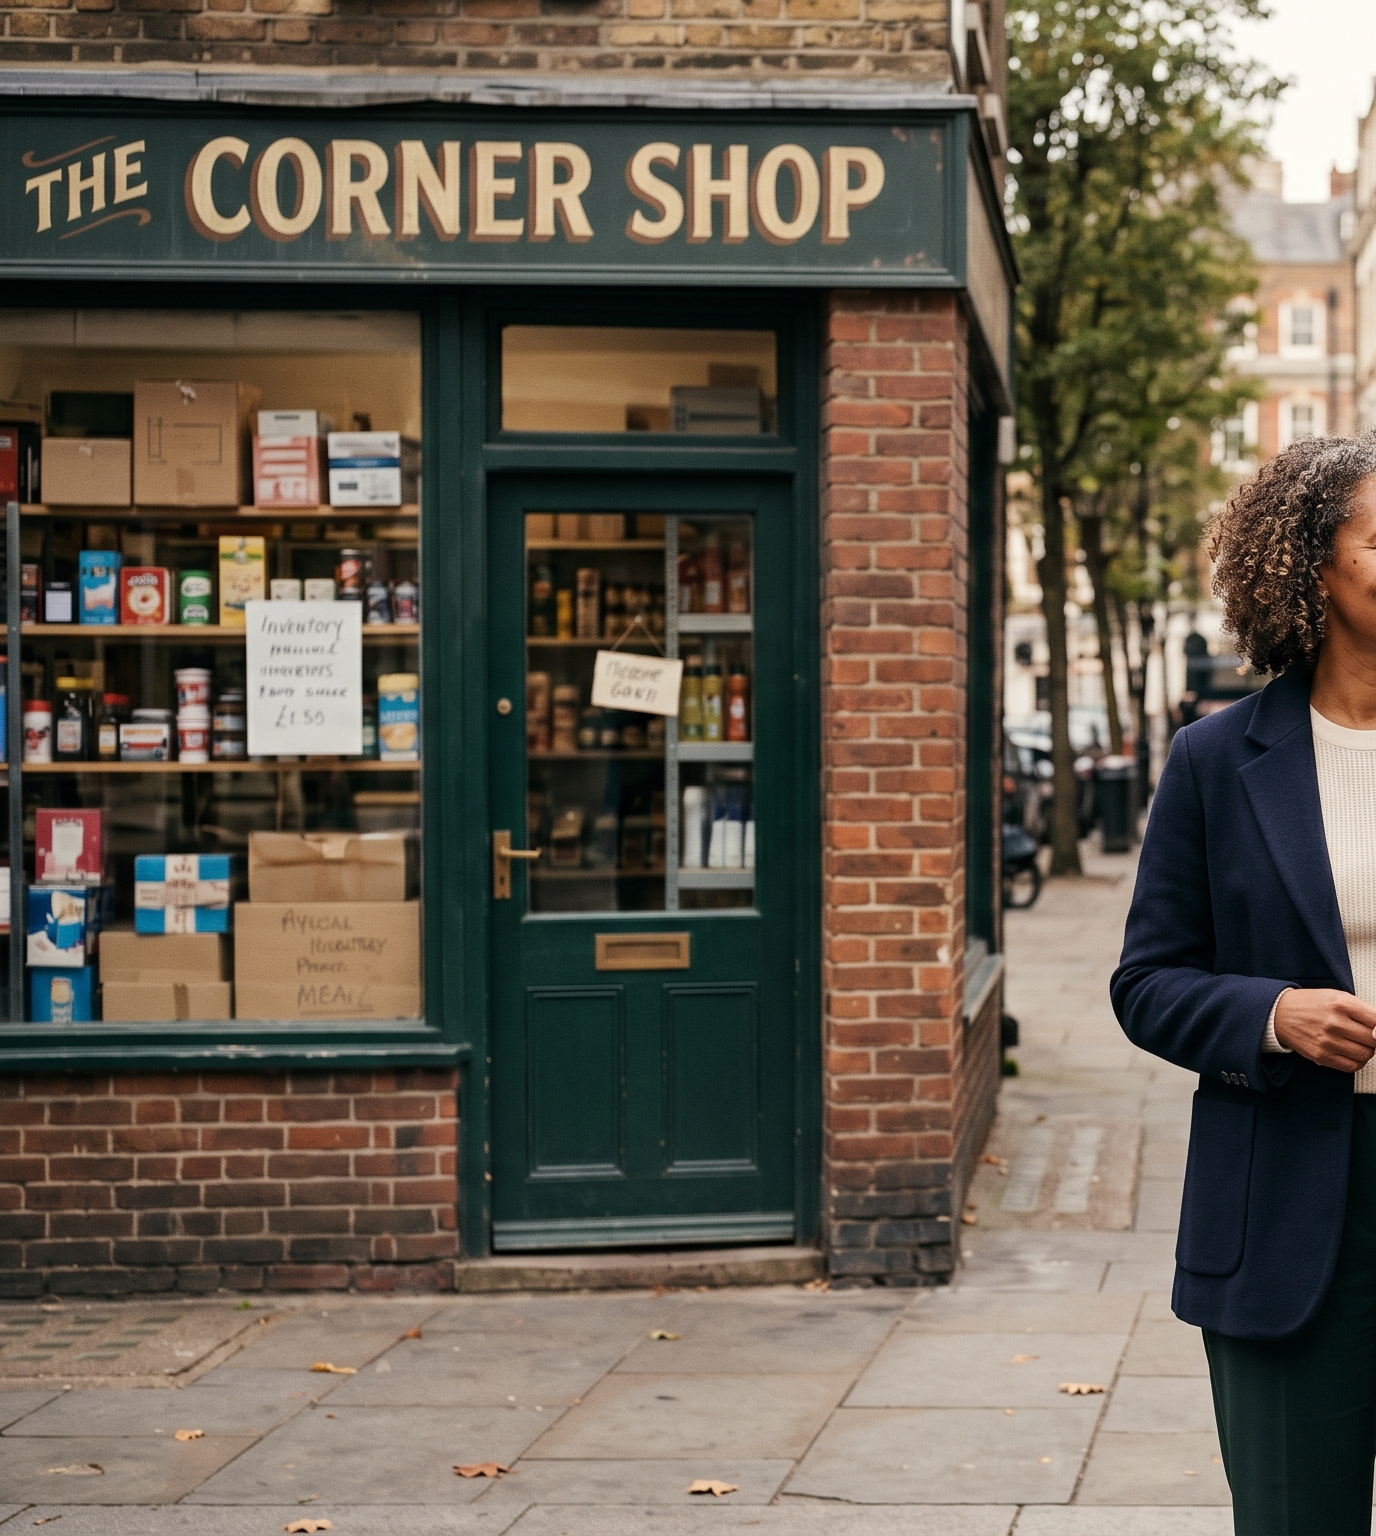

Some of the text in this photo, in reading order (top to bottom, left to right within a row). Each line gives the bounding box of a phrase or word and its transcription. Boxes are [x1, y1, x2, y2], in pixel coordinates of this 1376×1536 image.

[26, 136, 886, 246] THE CORNER SHOP
